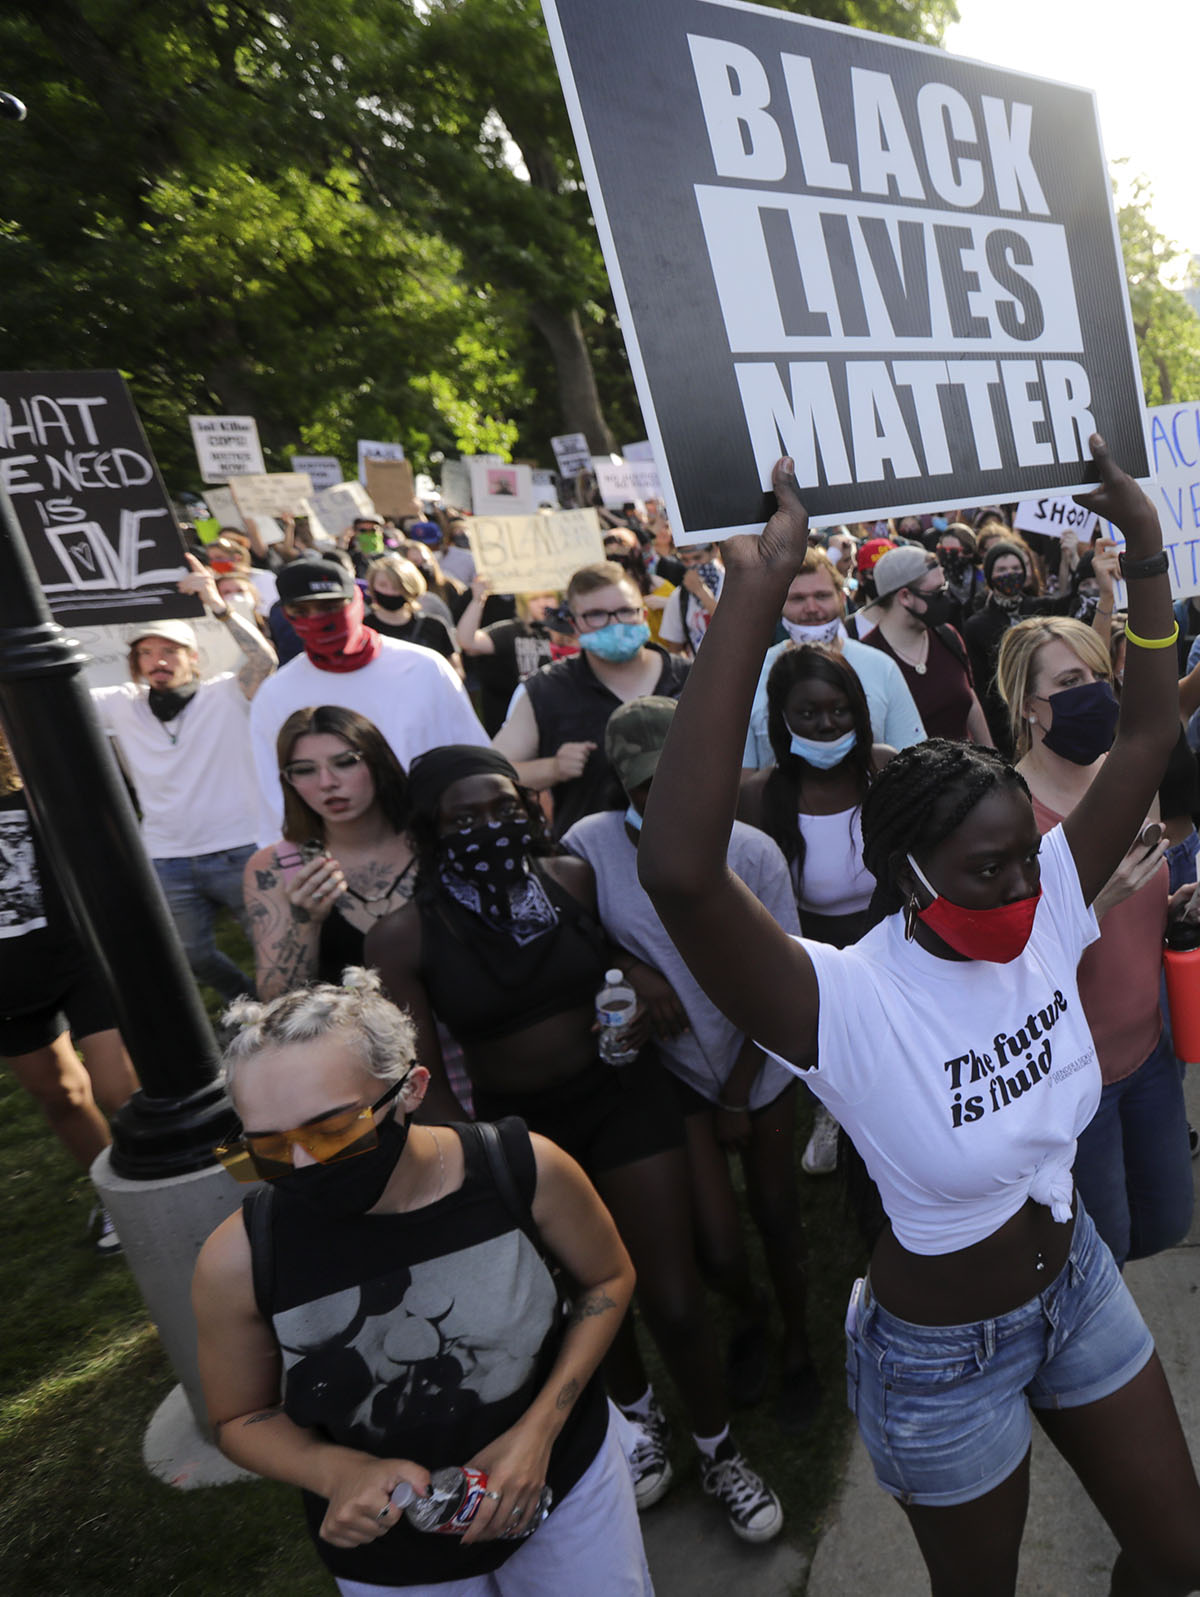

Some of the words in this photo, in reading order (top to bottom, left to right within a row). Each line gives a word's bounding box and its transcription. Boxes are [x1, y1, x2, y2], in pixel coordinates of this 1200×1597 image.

[687, 33, 1050, 216] BLACK
[757, 205, 1046, 342] LIVES
[45, 449, 153, 492] NEED
[733, 359, 1097, 493] MATTER
[34, 496, 87, 526] IS
[944, 1049, 996, 1090] The
[993, 989, 1068, 1069] future
[950, 1093, 985, 1129] is
[989, 1038, 1052, 1113] fluid
